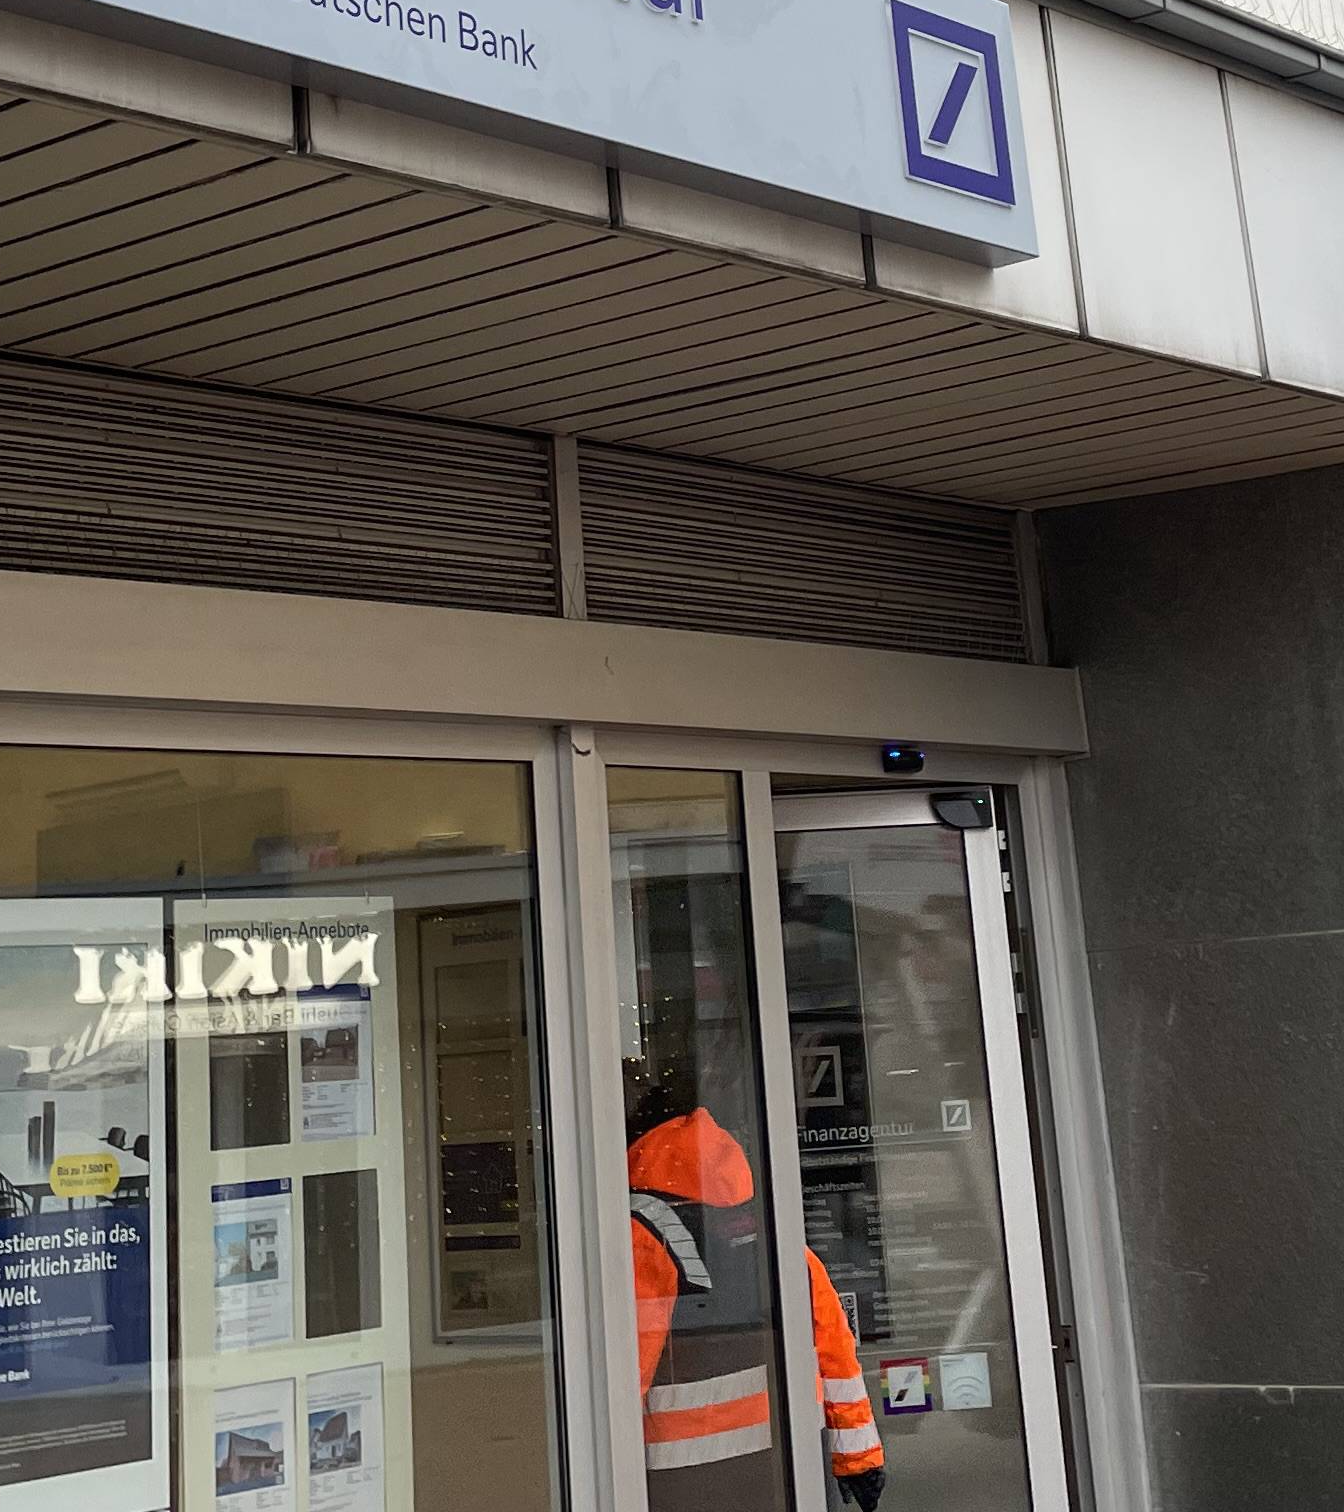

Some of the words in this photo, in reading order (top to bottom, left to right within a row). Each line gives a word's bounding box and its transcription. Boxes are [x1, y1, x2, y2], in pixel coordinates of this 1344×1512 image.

[458, 10, 538, 70] Bank
[205, 919, 369, 943] Immobilien-Angebote
[63, 1227, 89, 1248] Sie
[91, 1225, 106, 1245] in
[109, 1223, 141, 1244] das,
[4, 1254, 70, 1281] wirklich
[73, 1251, 118, 1274] zählt:
[7, 1368, 30, 1383] Bank
